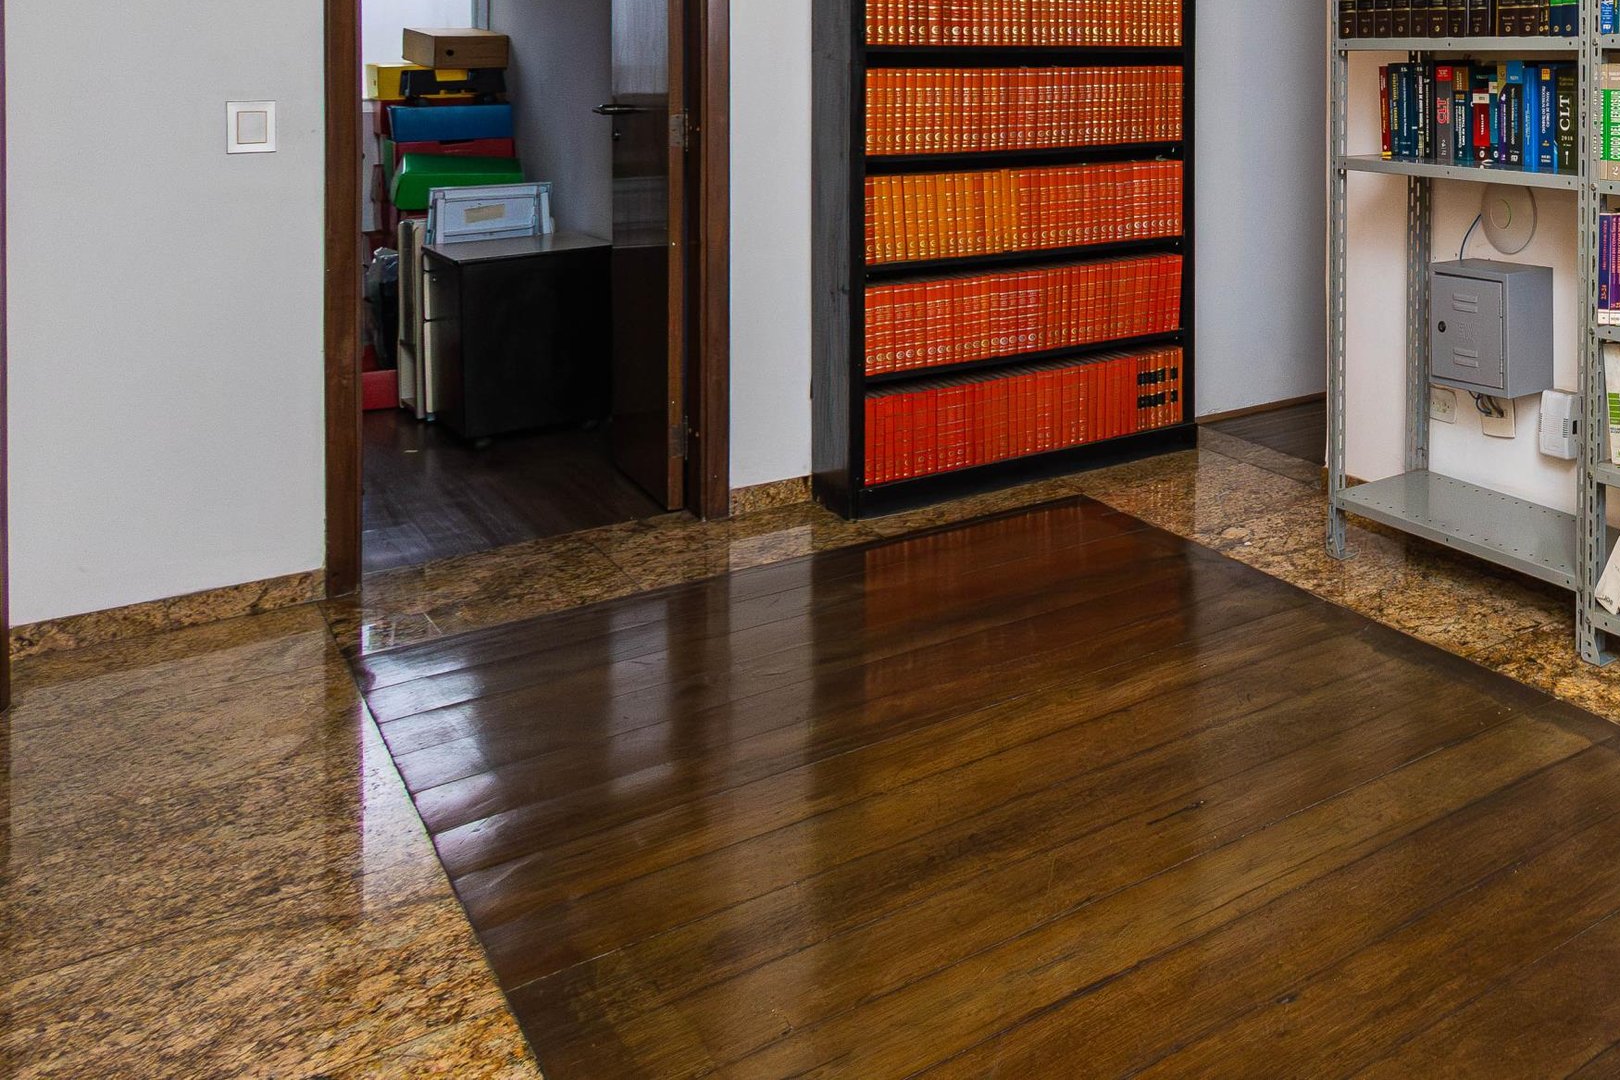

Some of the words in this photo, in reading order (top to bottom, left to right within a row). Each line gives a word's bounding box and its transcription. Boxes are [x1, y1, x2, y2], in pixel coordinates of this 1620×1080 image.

[1560, 95, 1570, 131] CLT
[1611, 90, 1620, 123] MERCOSUR
[1611, 124, 1620, 136] DEL
[1611, 166, 1619, 178] 2
